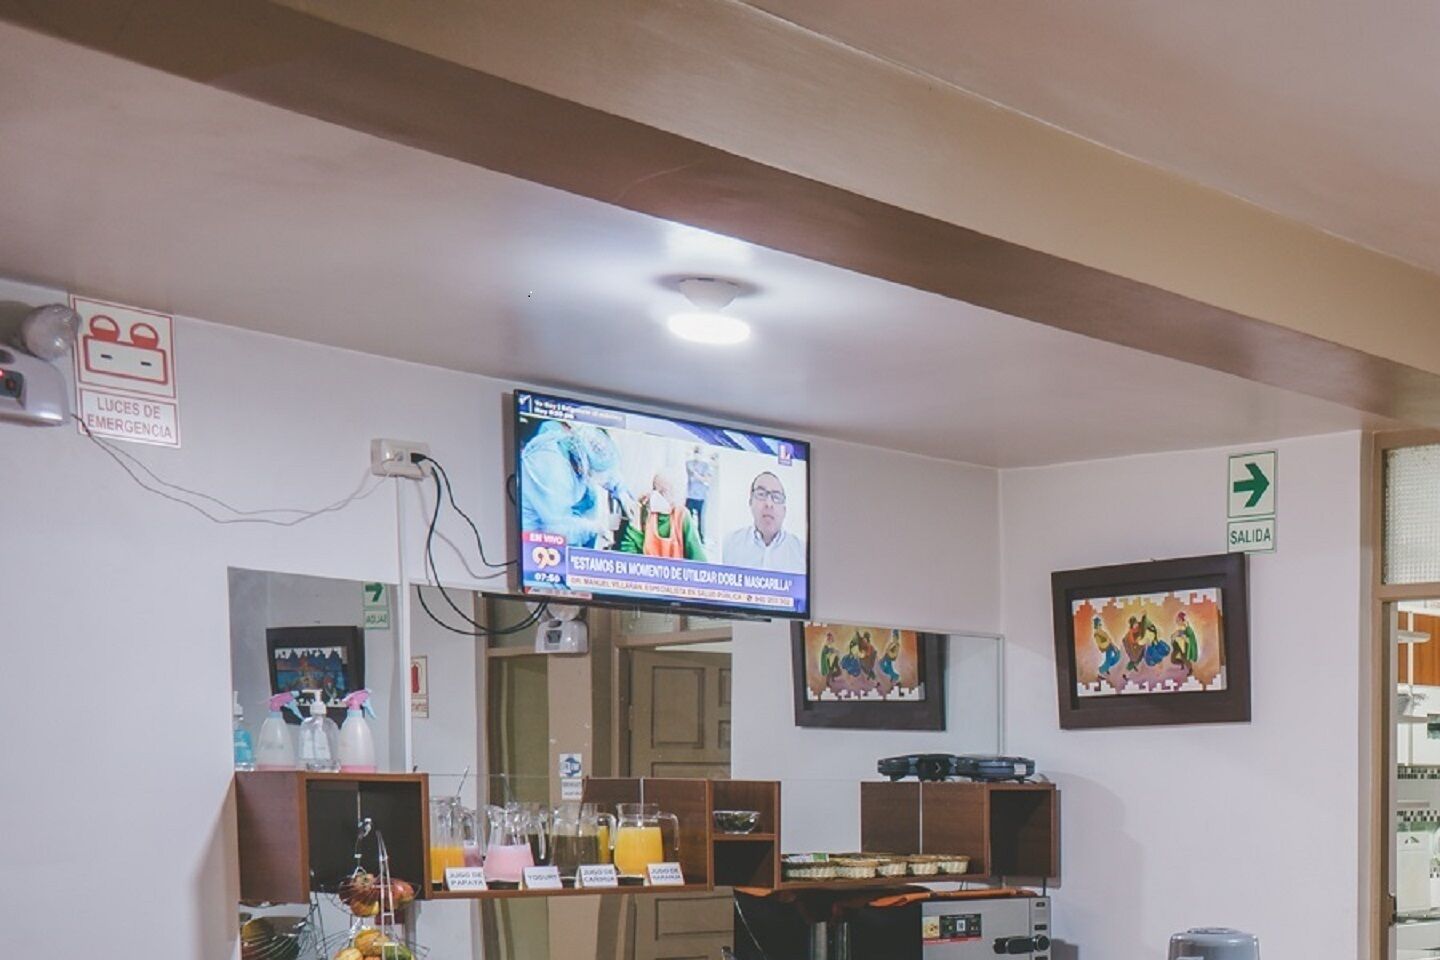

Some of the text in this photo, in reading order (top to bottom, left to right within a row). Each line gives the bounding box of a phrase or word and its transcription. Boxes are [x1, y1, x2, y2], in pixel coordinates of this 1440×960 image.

[97, 397, 161, 419] LUCES DE
[87, 414, 172, 438] EMERGENCIA
[543, 534, 564, 545] VIVO
[1230, 527, 1271, 545] SALIDA
[570, 555, 614, 573] "ESTAMOS
[616, 561, 628, 575] EN
[629, 562, 669, 580] MOMENTO
[671, 567, 682, 580] DE
[683, 568, 717, 584] UTILIZAR
[718, 572, 743, 587] DOBLE
